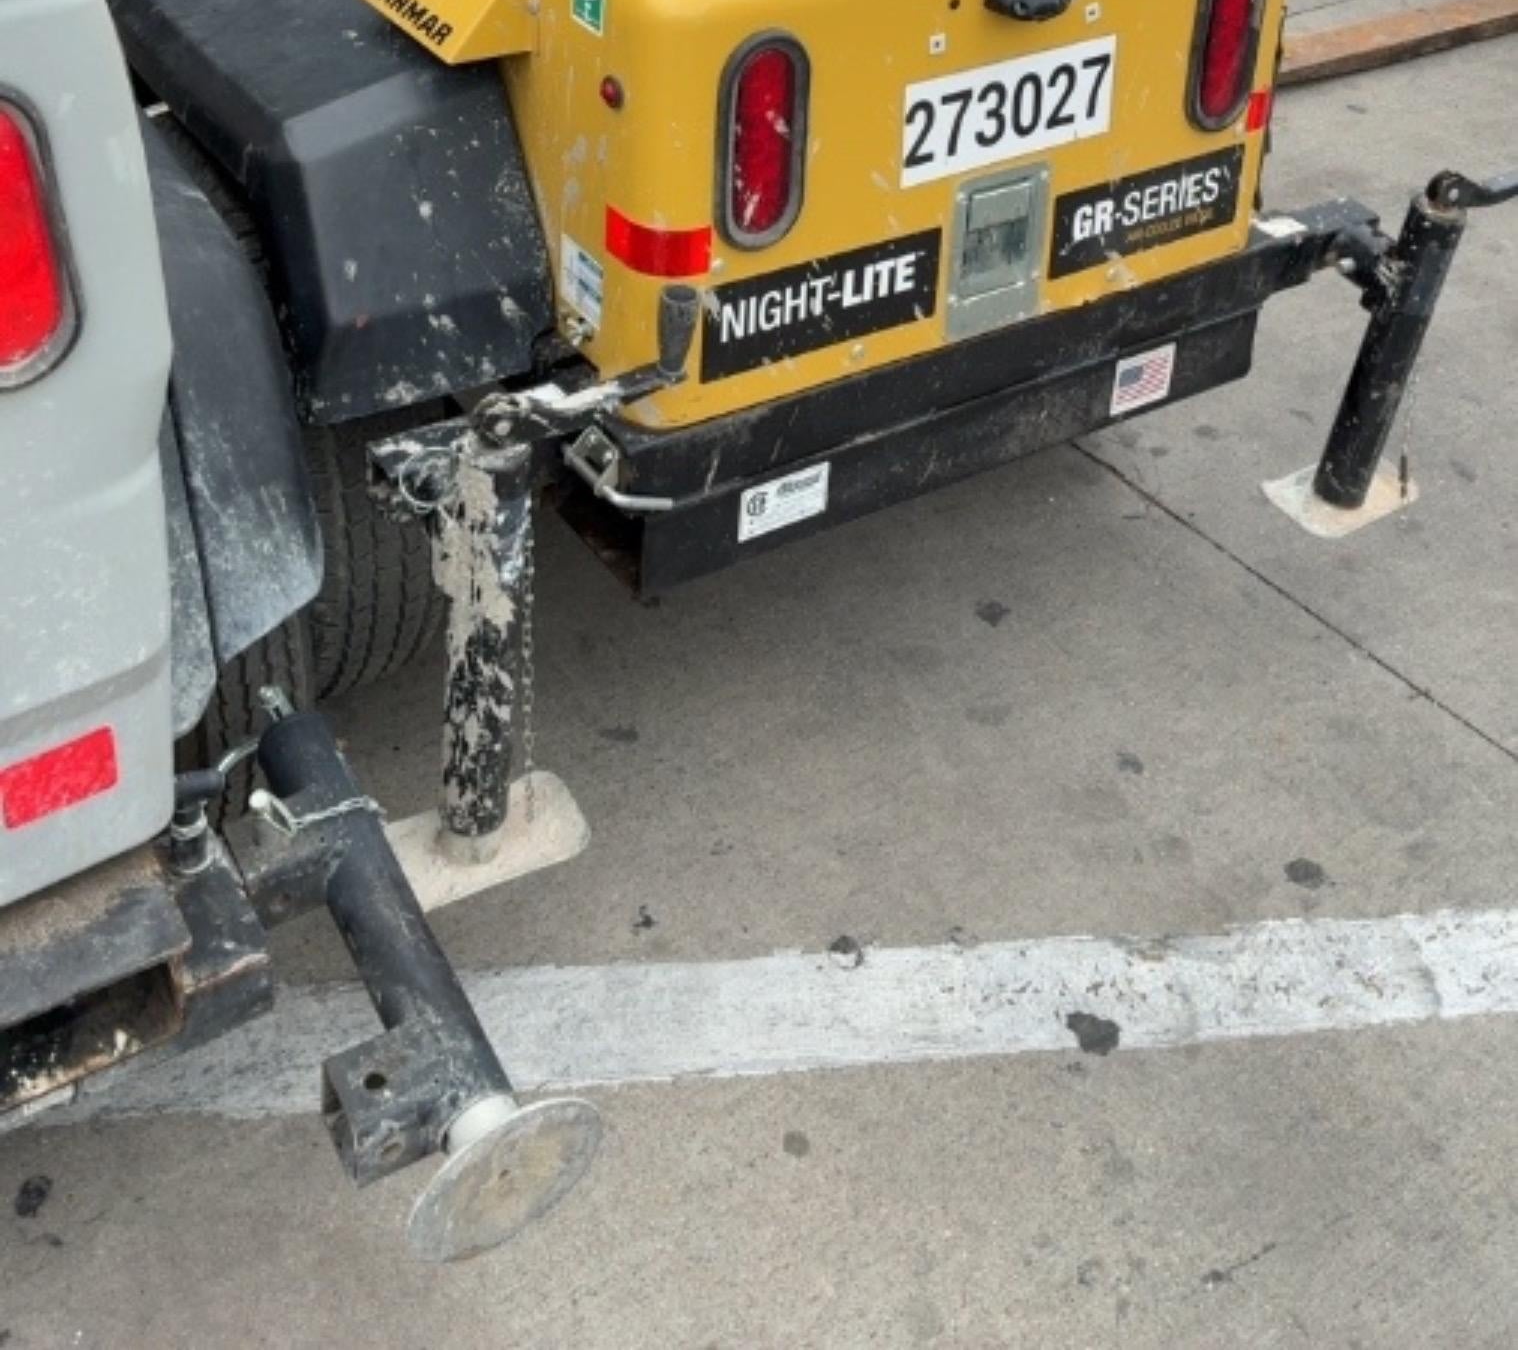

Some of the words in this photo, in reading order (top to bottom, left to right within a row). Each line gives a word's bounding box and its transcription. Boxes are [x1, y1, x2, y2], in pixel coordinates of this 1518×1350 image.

[904, 53, 1112, 169] 273027
[1072, 165, 1223, 243] GR-SERIES
[719, 252, 918, 344] NIGHT-LITE
